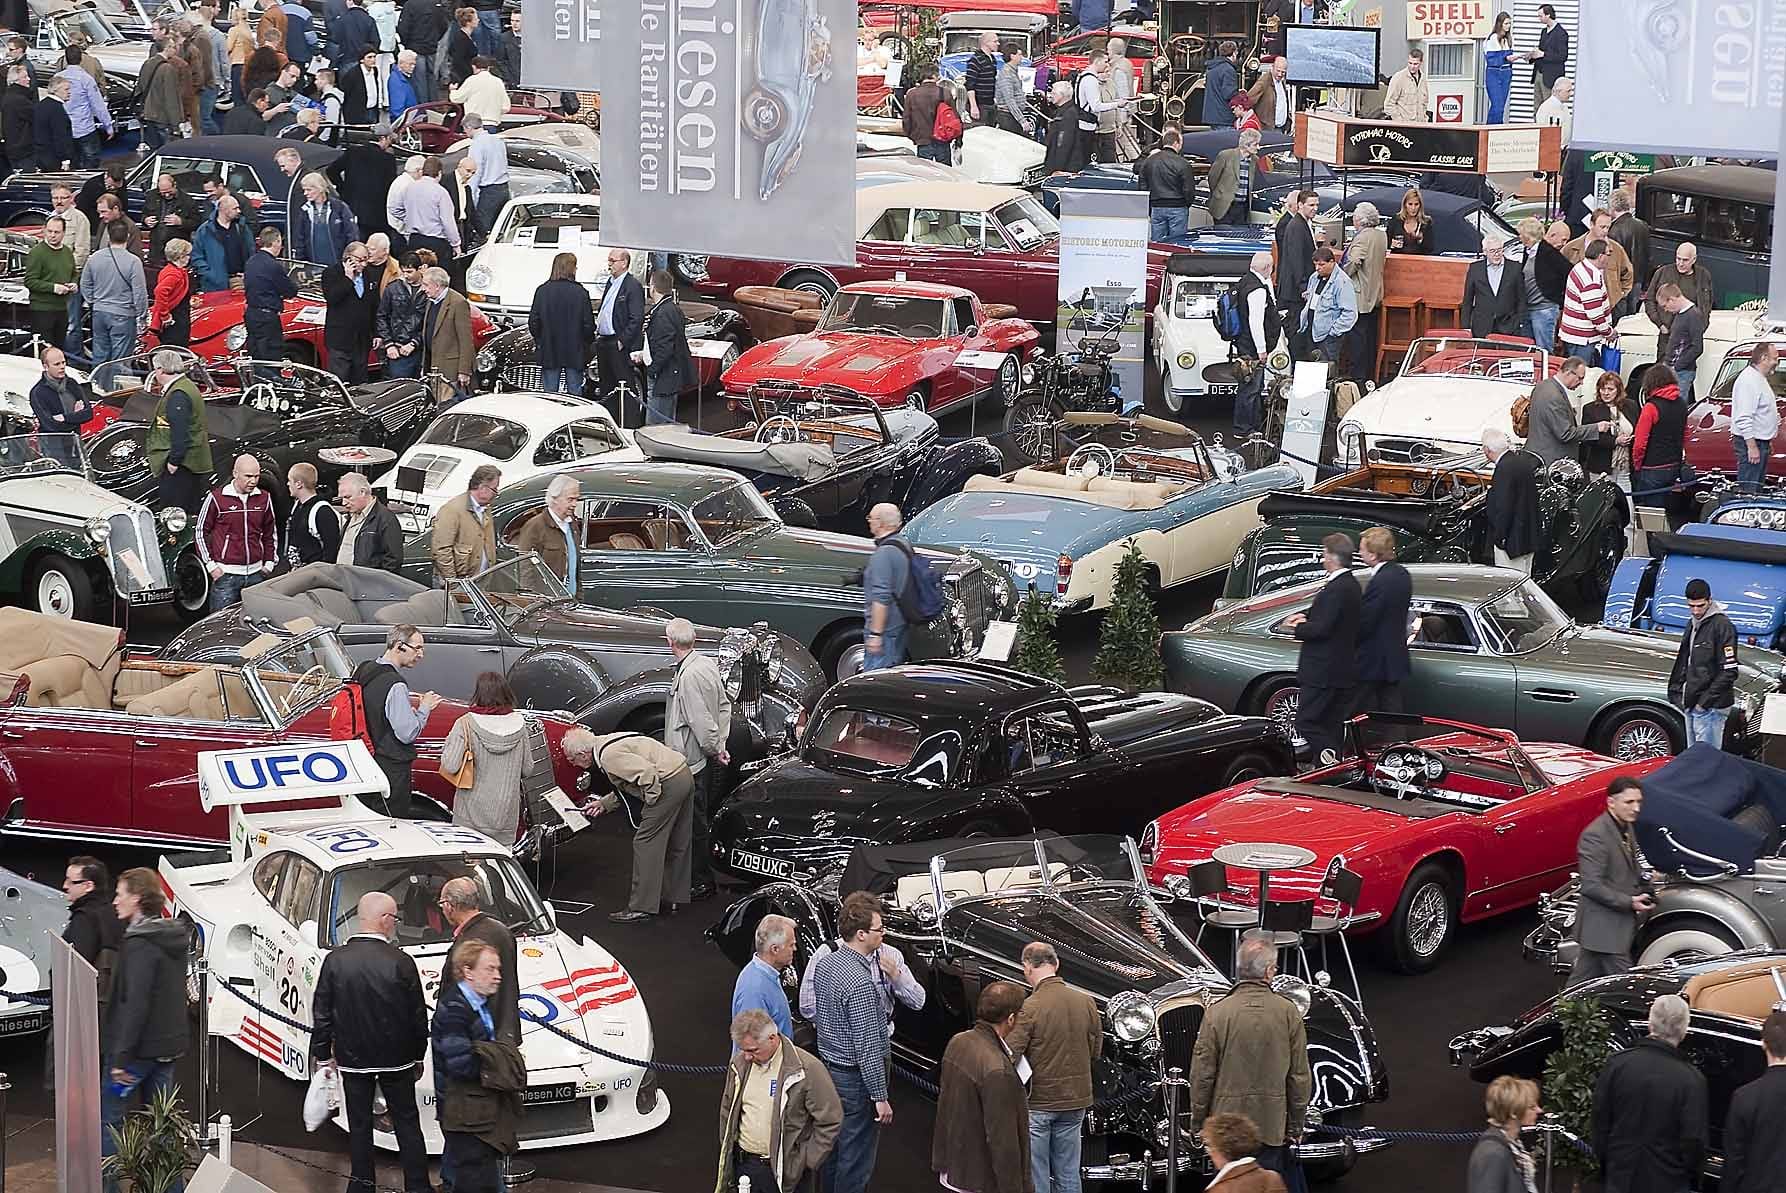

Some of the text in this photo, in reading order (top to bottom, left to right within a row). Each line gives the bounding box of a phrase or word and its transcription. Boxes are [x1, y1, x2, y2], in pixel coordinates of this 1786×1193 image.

[1415, 3, 1485, 21] SHELL
[1423, 21, 1475, 36] DEPOT
[640, 40, 666, 193] Raritäten
[1350, 128, 1384, 146] POTOMAC
[1385, 129, 1414, 149] MOTORS
[1430, 154, 1474, 165] CLASSIC CARS
[1106, 279, 1122, 287] Esso
[1023, 565, 1032, 576] D
[224, 751, 348, 790] UFO
[280, 976, 299, 1015] 20
[282, 1043, 305, 1074] UFO
[555, 1086, 572, 1098] KG
[613, 1078, 632, 1091] UFO
